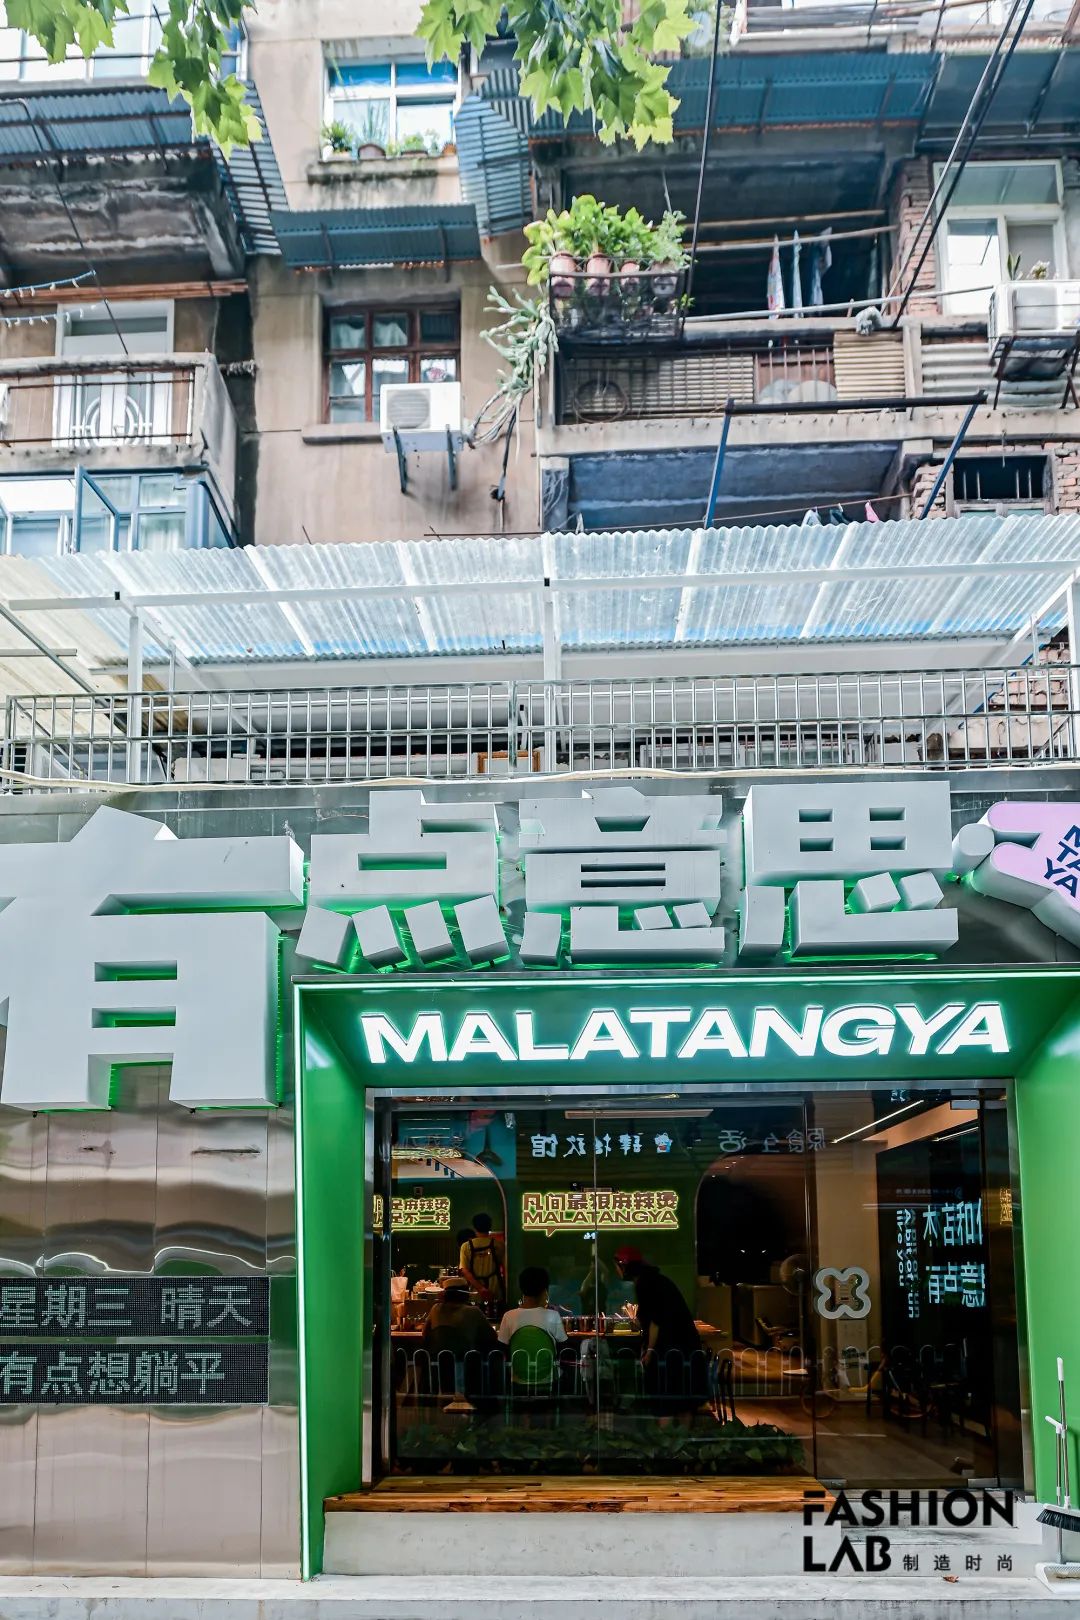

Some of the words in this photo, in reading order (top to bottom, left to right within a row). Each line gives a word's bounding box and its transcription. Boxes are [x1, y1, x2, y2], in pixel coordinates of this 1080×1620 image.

[0, 781, 958, 1110] 有点意思
[360, 1002, 1010, 1064] MALATANGYA
[523, 1210, 678, 1223] MALATANGYA
[0, 1284, 132, 1329] 星期三
[160, 1284, 253, 1330] 晴天
[0, 1350, 225, 1396] 有点想躺平
